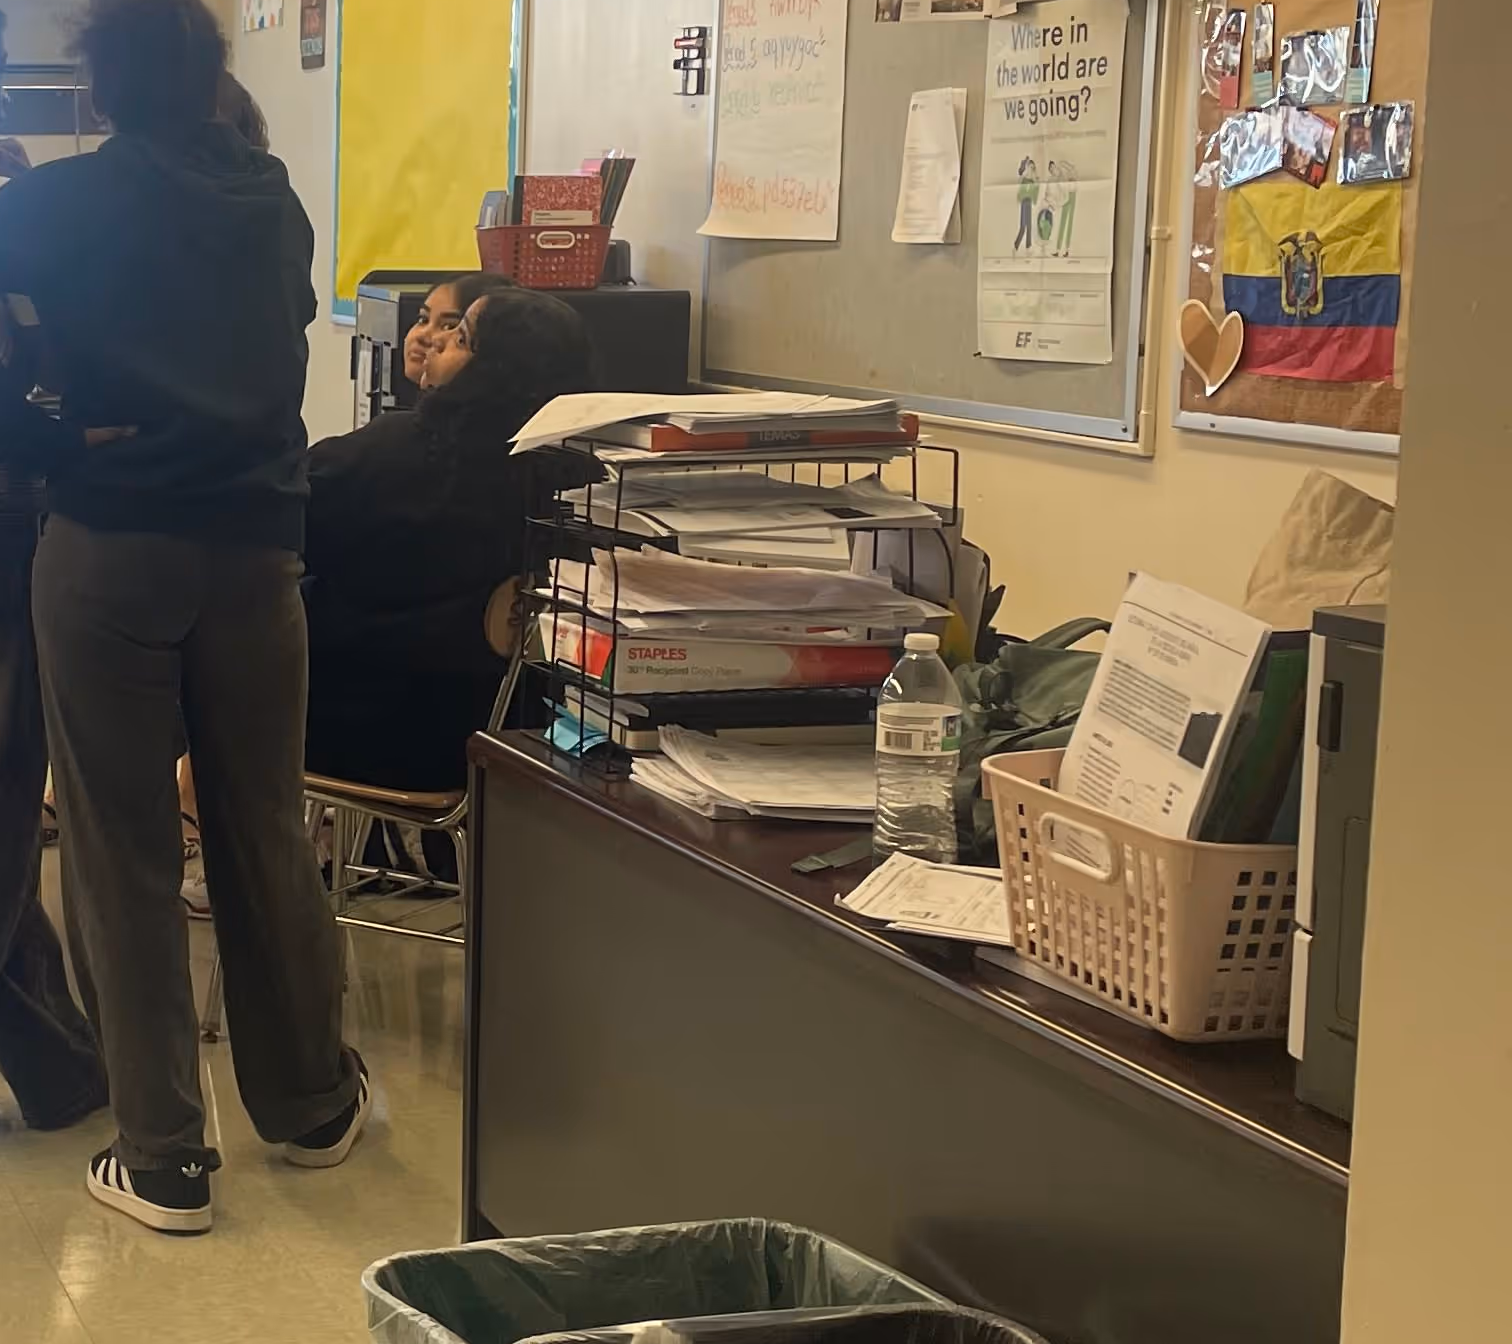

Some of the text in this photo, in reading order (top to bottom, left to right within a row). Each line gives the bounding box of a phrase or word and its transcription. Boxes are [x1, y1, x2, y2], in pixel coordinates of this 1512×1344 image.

[1011, 15, 1088, 52] Where in
[996, 51, 1108, 87] the world are
[1004, 85, 1092, 126] we going?
[1015, 331, 1033, 348] EF
[628, 647, 687, 661] STAPLES
